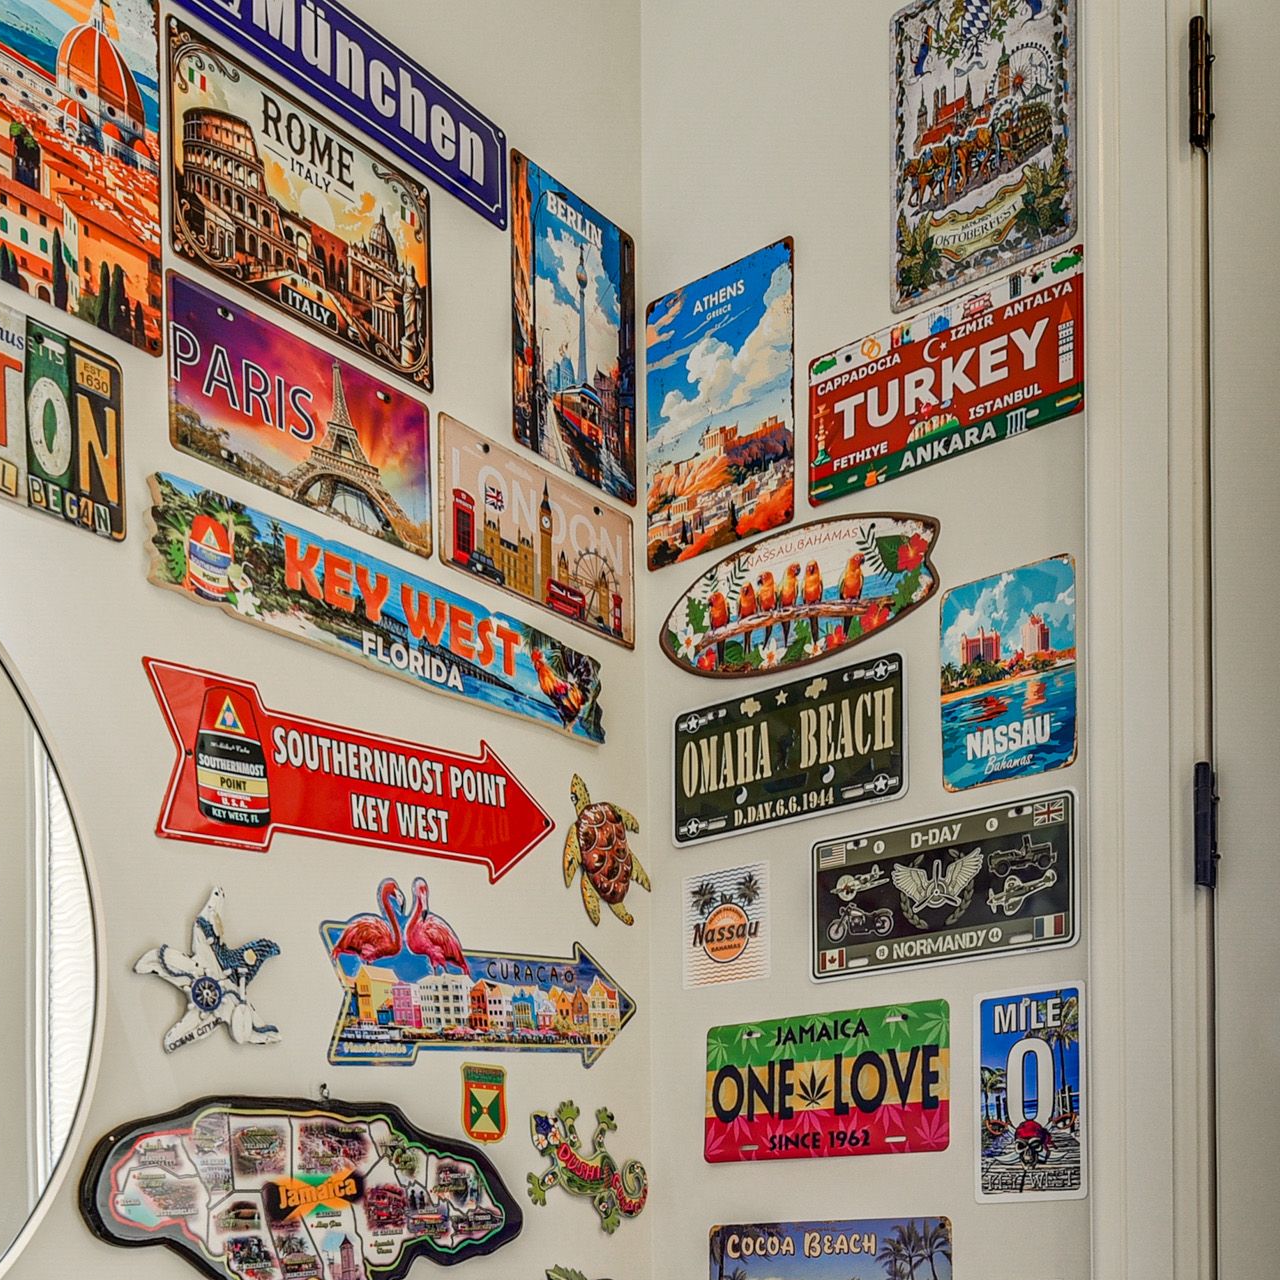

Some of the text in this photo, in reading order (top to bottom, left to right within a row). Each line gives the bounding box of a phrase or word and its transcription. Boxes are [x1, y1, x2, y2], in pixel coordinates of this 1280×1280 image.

[251, 0, 487, 187] München
[259, 90, 357, 192] ROME
[289, 156, 334, 197] ITALY
[545, 188, 604, 252] BERLIN
[935, 200, 1018, 247] OKTOBERFEST
[286, 289, 333, 328] ITALY
[692, 279, 746, 316] ATHENS
[705, 302, 733, 323] GREECE
[950, 281, 1073, 342] IZMIR ANTALYA
[78, 369, 111, 395] 1630
[168, 320, 316, 444] PARIS
[816, 352, 902, 396] CAPPADOCIA
[833, 317, 1050, 442] TURKEY
[967, 383, 1044, 421] ISTANBUL
[832, 440, 889, 472] FETHIYE
[898, 421, 998, 473] ANKARA
[29, 475, 112, 539] BEGAN
[450, 446, 624, 579] LONDON
[282, 532, 523, 679] KEY WEST
[361, 630, 464, 693] FLORIDA
[681, 686, 895, 800] OMAHA BEACH
[966, 712, 1052, 762] NASSAU
[198, 753, 265, 778] SOUTHERNMOST
[220, 776, 248, 792] POINT
[272, 724, 508, 809] SOUTHERNMOST POINT
[984, 751, 1035, 776] Bahamas
[211, 807, 228, 819] KEY
[250, 813, 260, 824] FL
[350, 793, 449, 845] KEY WEST
[911, 823, 962, 849] D-DAY
[692, 920, 760, 948] Nassau
[892, 929, 988, 960] NORMANDY
[775, 1017, 869, 1048] JAMAICA
[993, 995, 1063, 1036] MILE
[168, 1022, 212, 1051] OCEAN CITY
[711, 1044, 940, 1124] ONE LOVE
[1006, 1036, 1056, 1124] 0
[768, 1128, 871, 1153] SINCE 1962
[558, 1143, 601, 1181] DUSHI
[276, 1175, 358, 1212] Jamaica
[726, 1231, 878, 1260] COCOA BEACH
